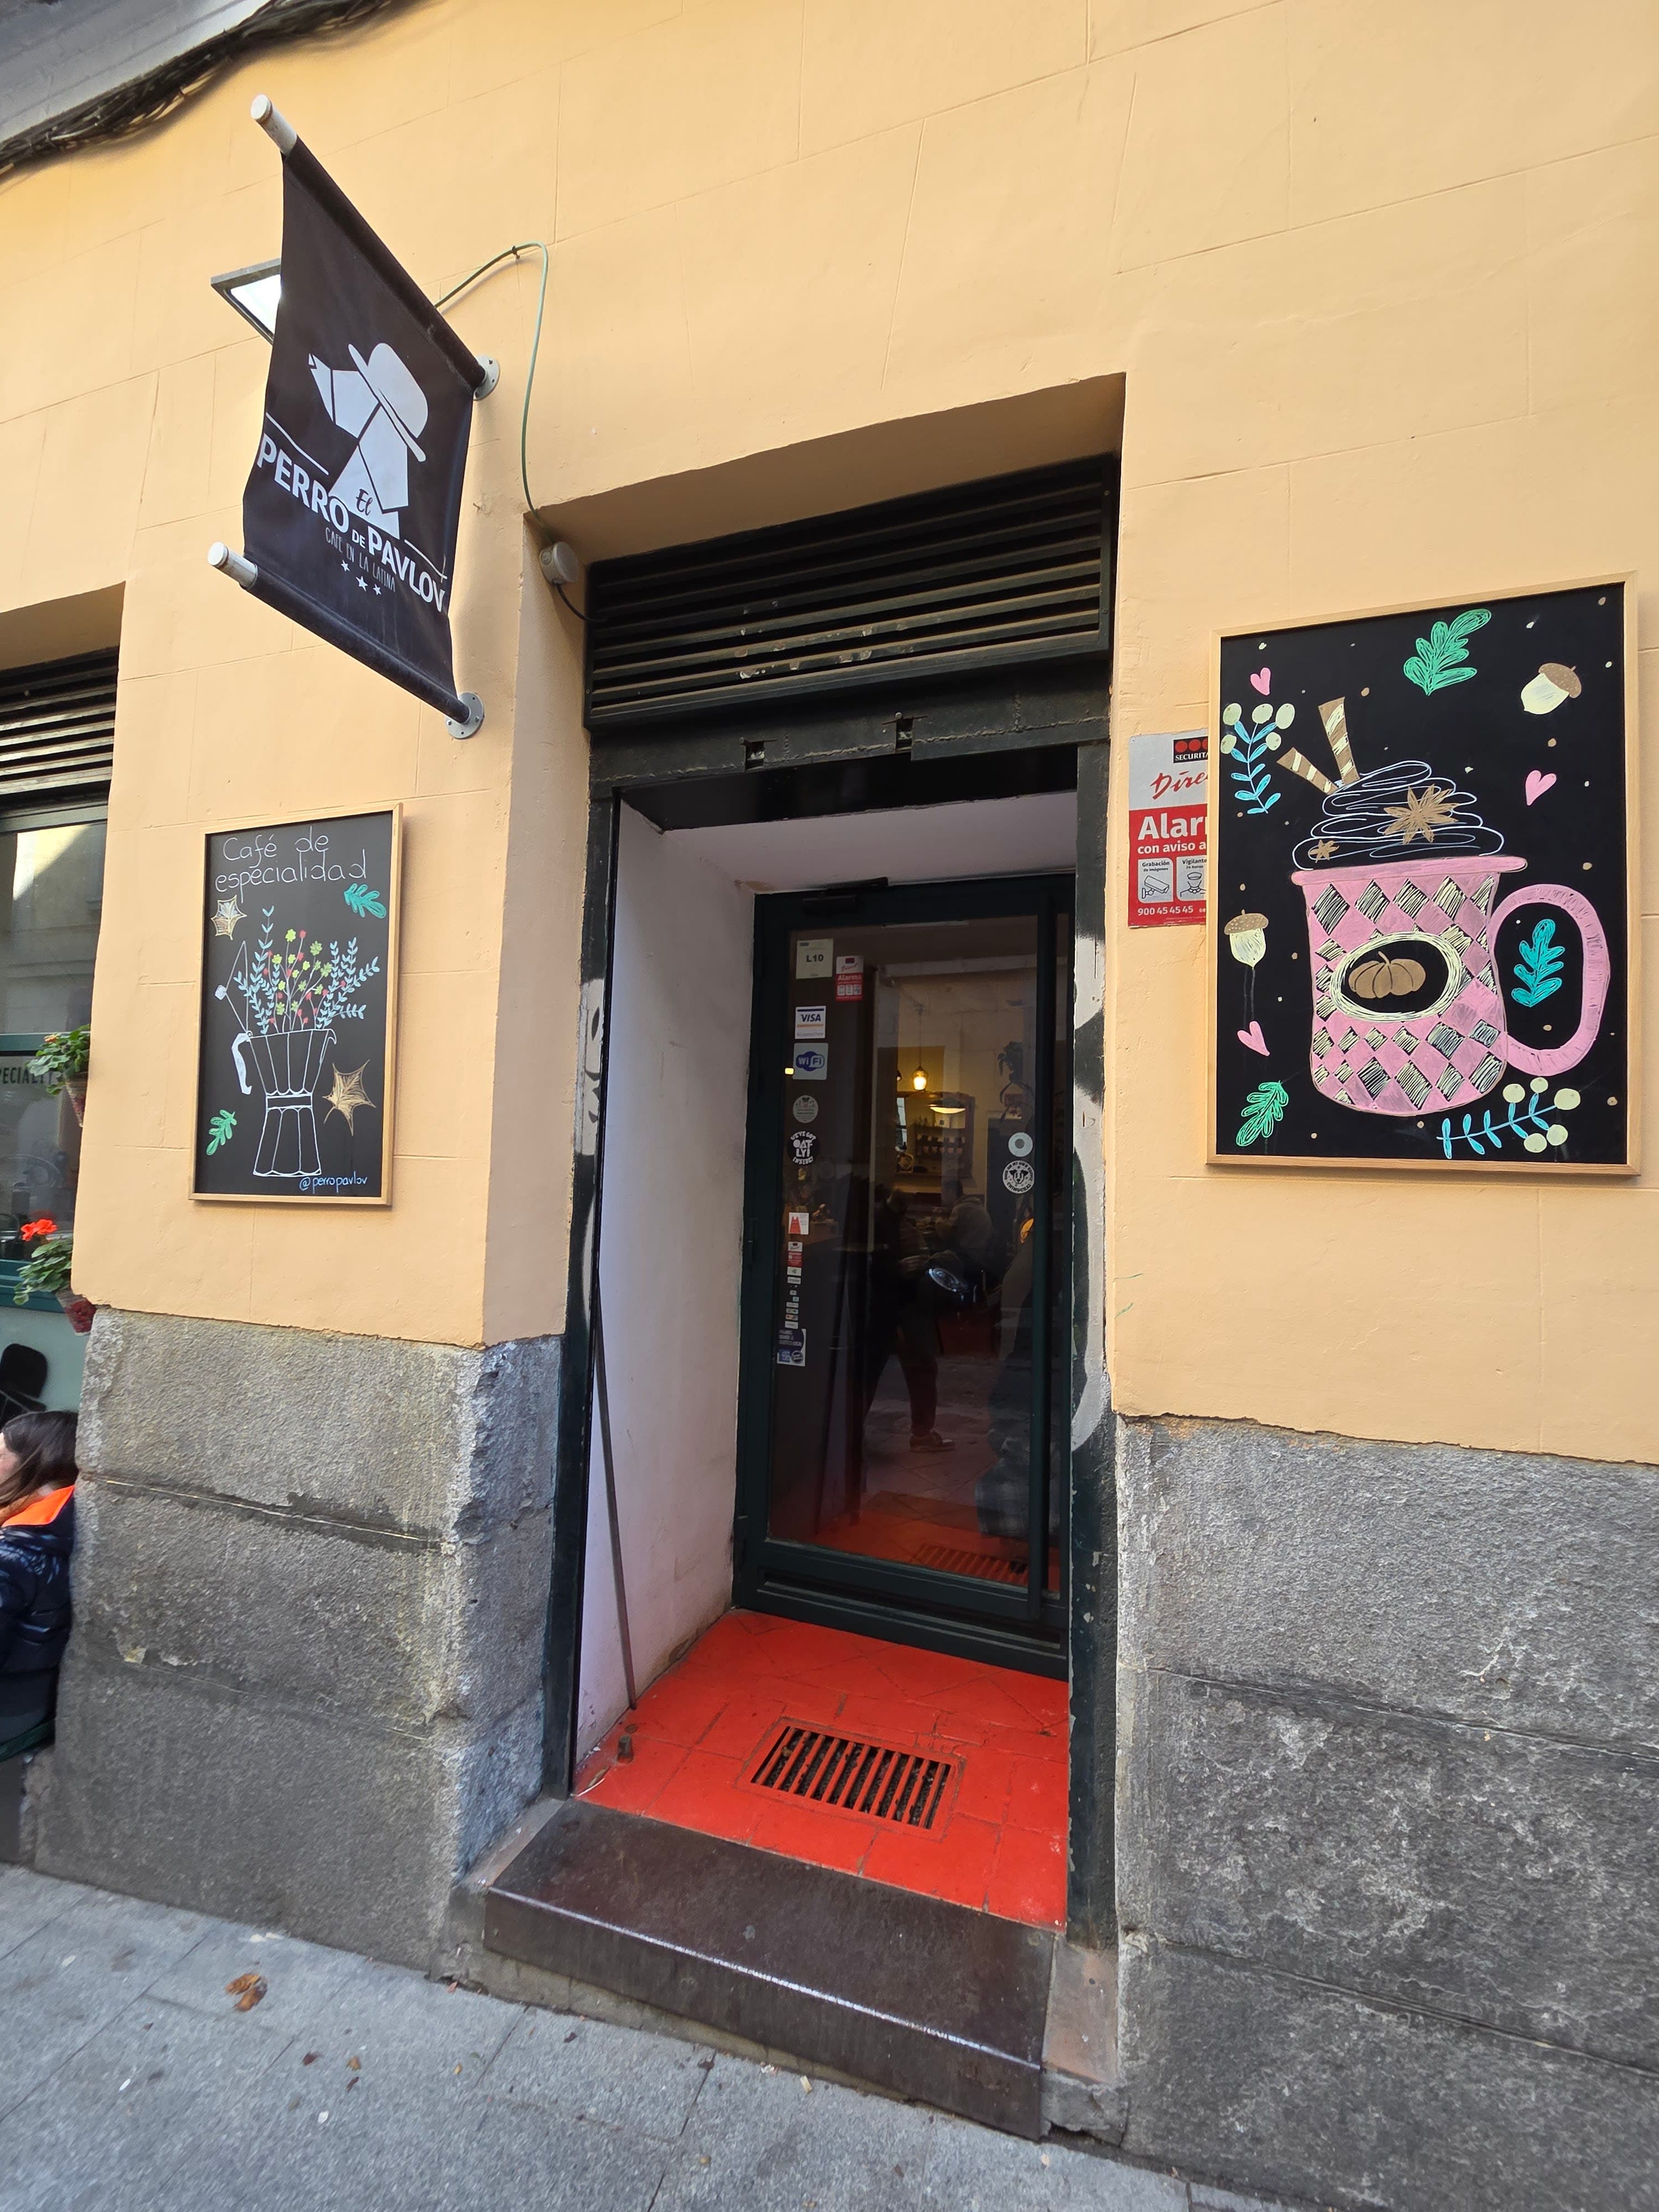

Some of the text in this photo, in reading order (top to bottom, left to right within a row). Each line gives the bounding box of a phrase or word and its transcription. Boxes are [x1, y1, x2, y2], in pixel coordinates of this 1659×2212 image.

[356, 488, 373, 516] El
[257, 432, 446, 612] PERRO DE PAVLOV
[325, 526, 395, 592] CAFE EN LA LATINA
[1150, 770, 1208, 800] Dire
[1138, 812, 1207, 840] Alar
[223, 825, 328, 868] Café de
[1138, 844, 1159, 854] con
[1162, 840, 1196, 853] aviso
[215, 848, 366, 904] especialidad
[1138, 907, 1155, 916] 900
[1169, 906, 1181, 914] 45
[1182, 905, 1193, 914] 45
[801, 1014, 821, 1022] VISA
[299, 1171, 368, 1194] @perropavlov
